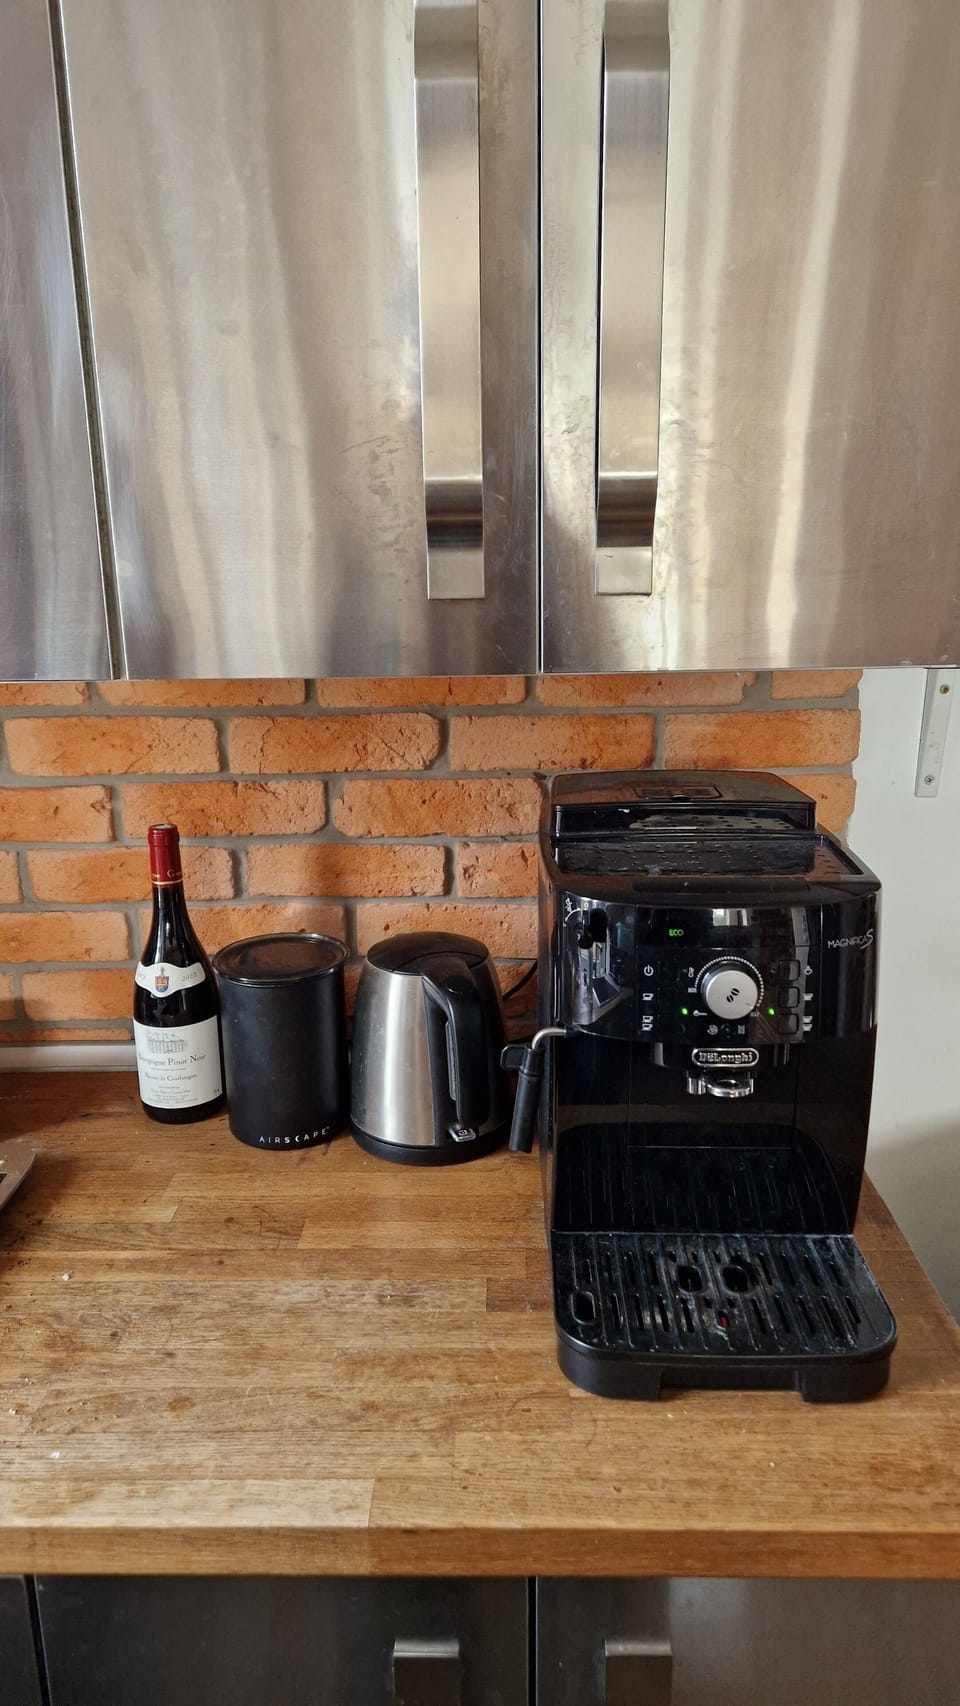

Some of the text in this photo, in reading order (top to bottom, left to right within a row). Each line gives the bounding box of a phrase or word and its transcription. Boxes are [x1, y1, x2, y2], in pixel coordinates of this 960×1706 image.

[669, 928, 684, 936] ECO
[167, 1057, 187, 1066] Pinot
[189, 1053, 206, 1064] Noir
[258, 1126, 326, 1144] AIRSCAPE
